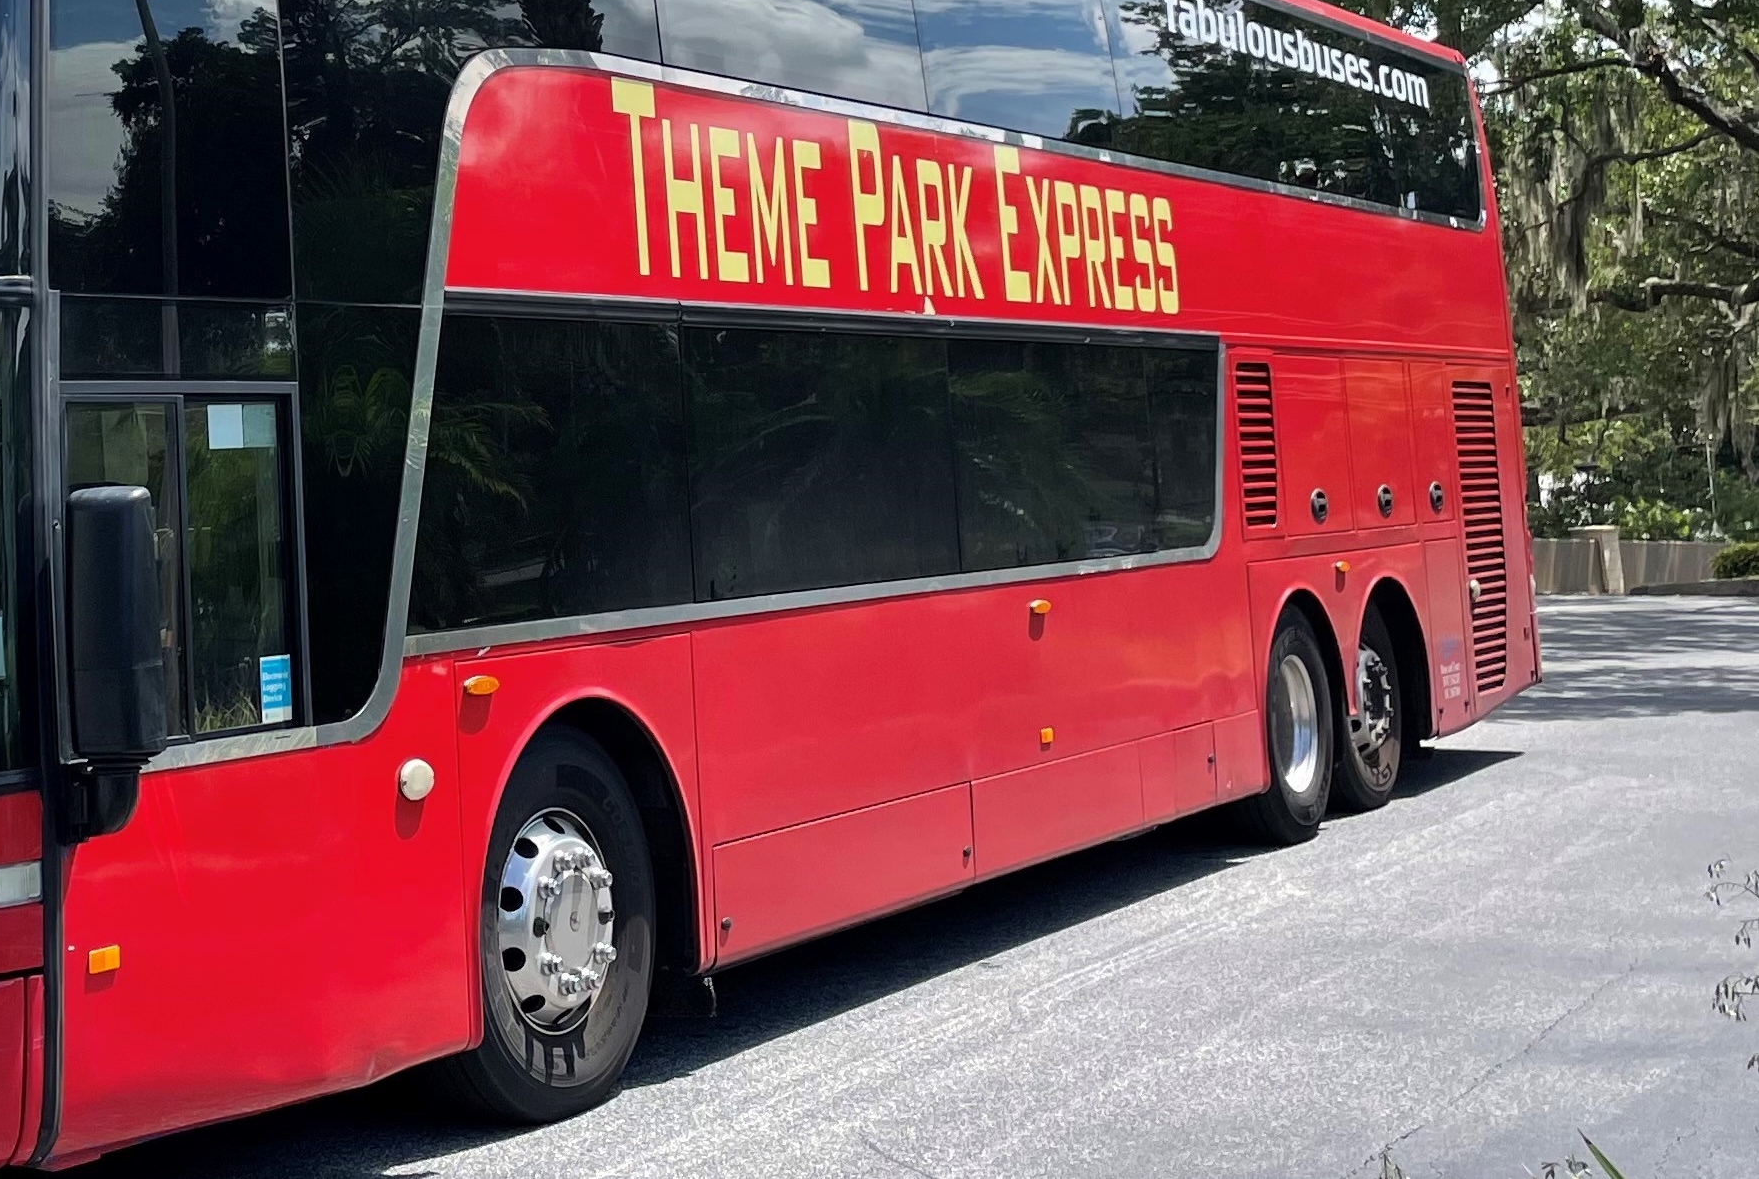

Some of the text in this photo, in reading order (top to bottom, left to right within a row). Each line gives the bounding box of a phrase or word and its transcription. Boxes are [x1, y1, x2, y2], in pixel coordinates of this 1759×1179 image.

[610, 75, 1181, 316] THEME PARK EXPRESS
